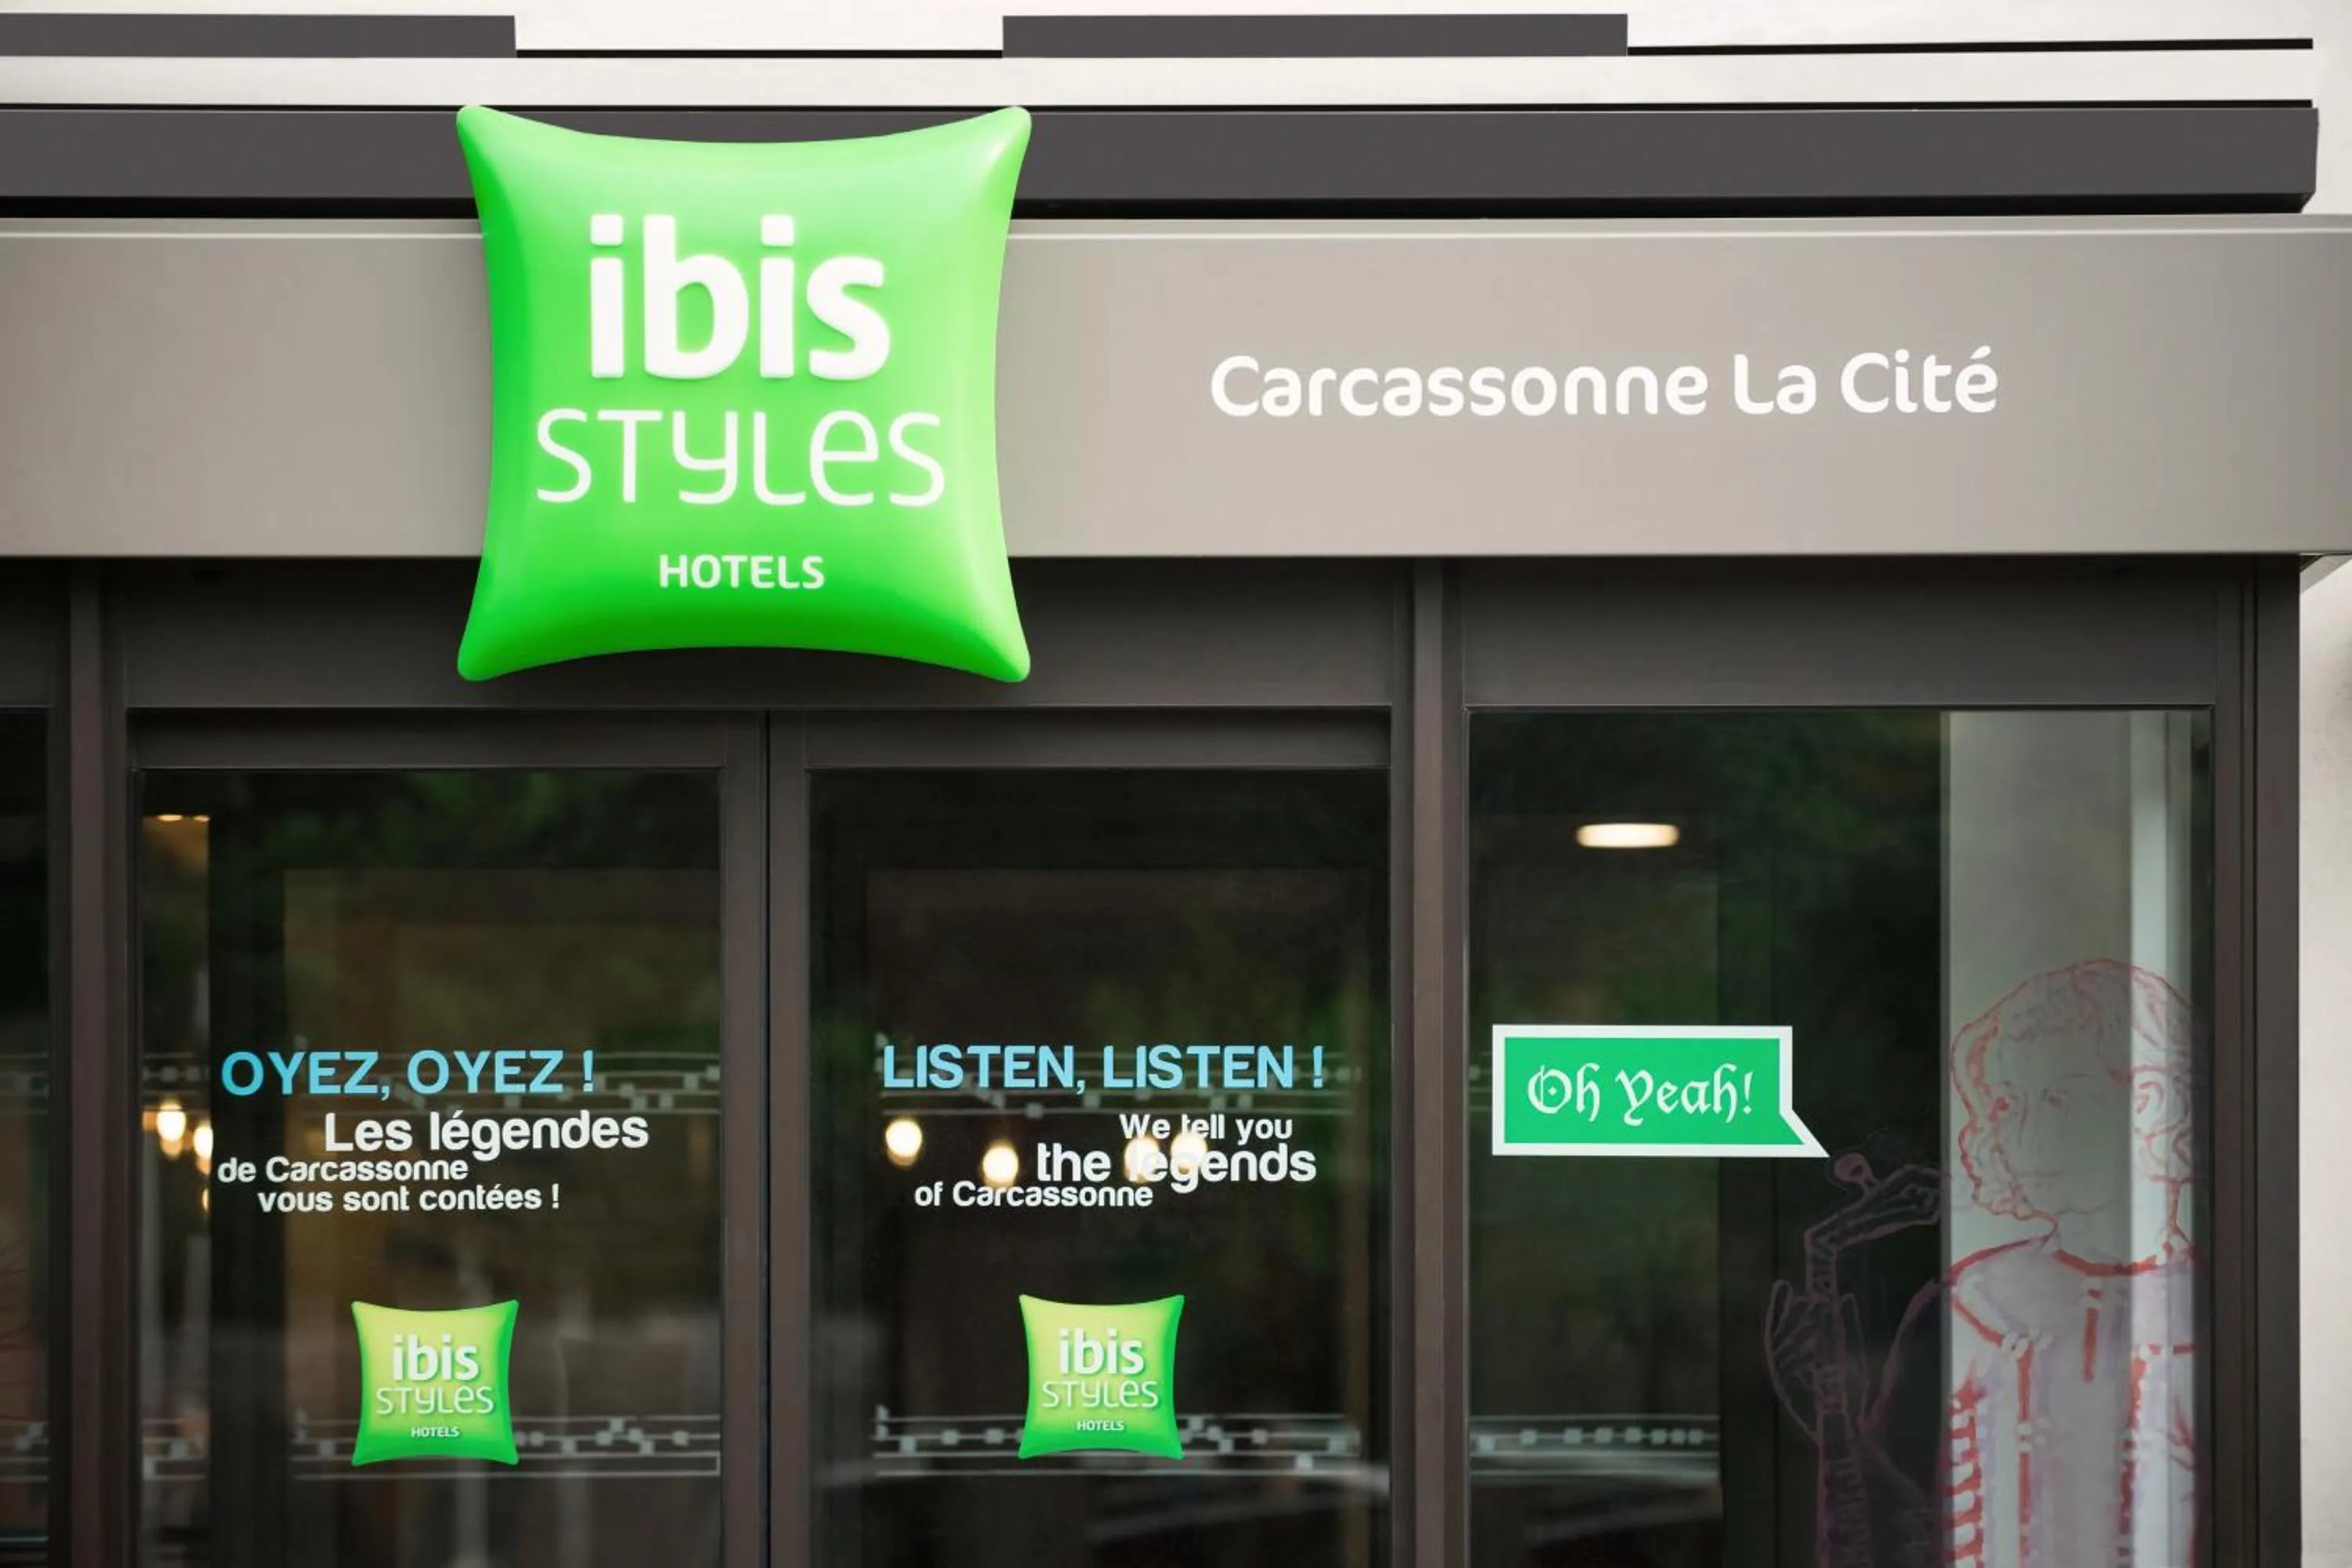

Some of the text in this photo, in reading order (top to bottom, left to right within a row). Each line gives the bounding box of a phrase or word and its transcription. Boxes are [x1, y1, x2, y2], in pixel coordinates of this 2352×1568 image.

[590, 212, 891, 379] ibis
[1210, 345, 1998, 417] Carcassonne La Cité
[659, 554, 824, 589] HOTELS
[221, 1051, 390, 1101] OYEZ,
[406, 1049, 564, 1094] OYEZ
[883, 1044, 1086, 1094] LISTEN,
[1103, 1045, 1294, 1089] LISTEN
[1527, 1062, 1754, 1127] Oh Yeah!
[325, 1109, 649, 1161] Les légendes
[1119, 1113, 1293, 1145] We tell you
[217, 1156, 469, 1183] de Carcassonne
[1036, 1142, 1112, 1182] the
[257, 1189, 334, 1212] vous
[343, 1185, 410, 1211] sont
[418, 1183, 543, 1211] contées
[914, 1181, 1154, 1207] of Carcassonne
[393, 1334, 479, 1380] ibis
[1058, 1327, 1145, 1374] ibis
[411, 1426, 459, 1438] HOTELS
[1076, 1420, 1124, 1431] HOTELS
